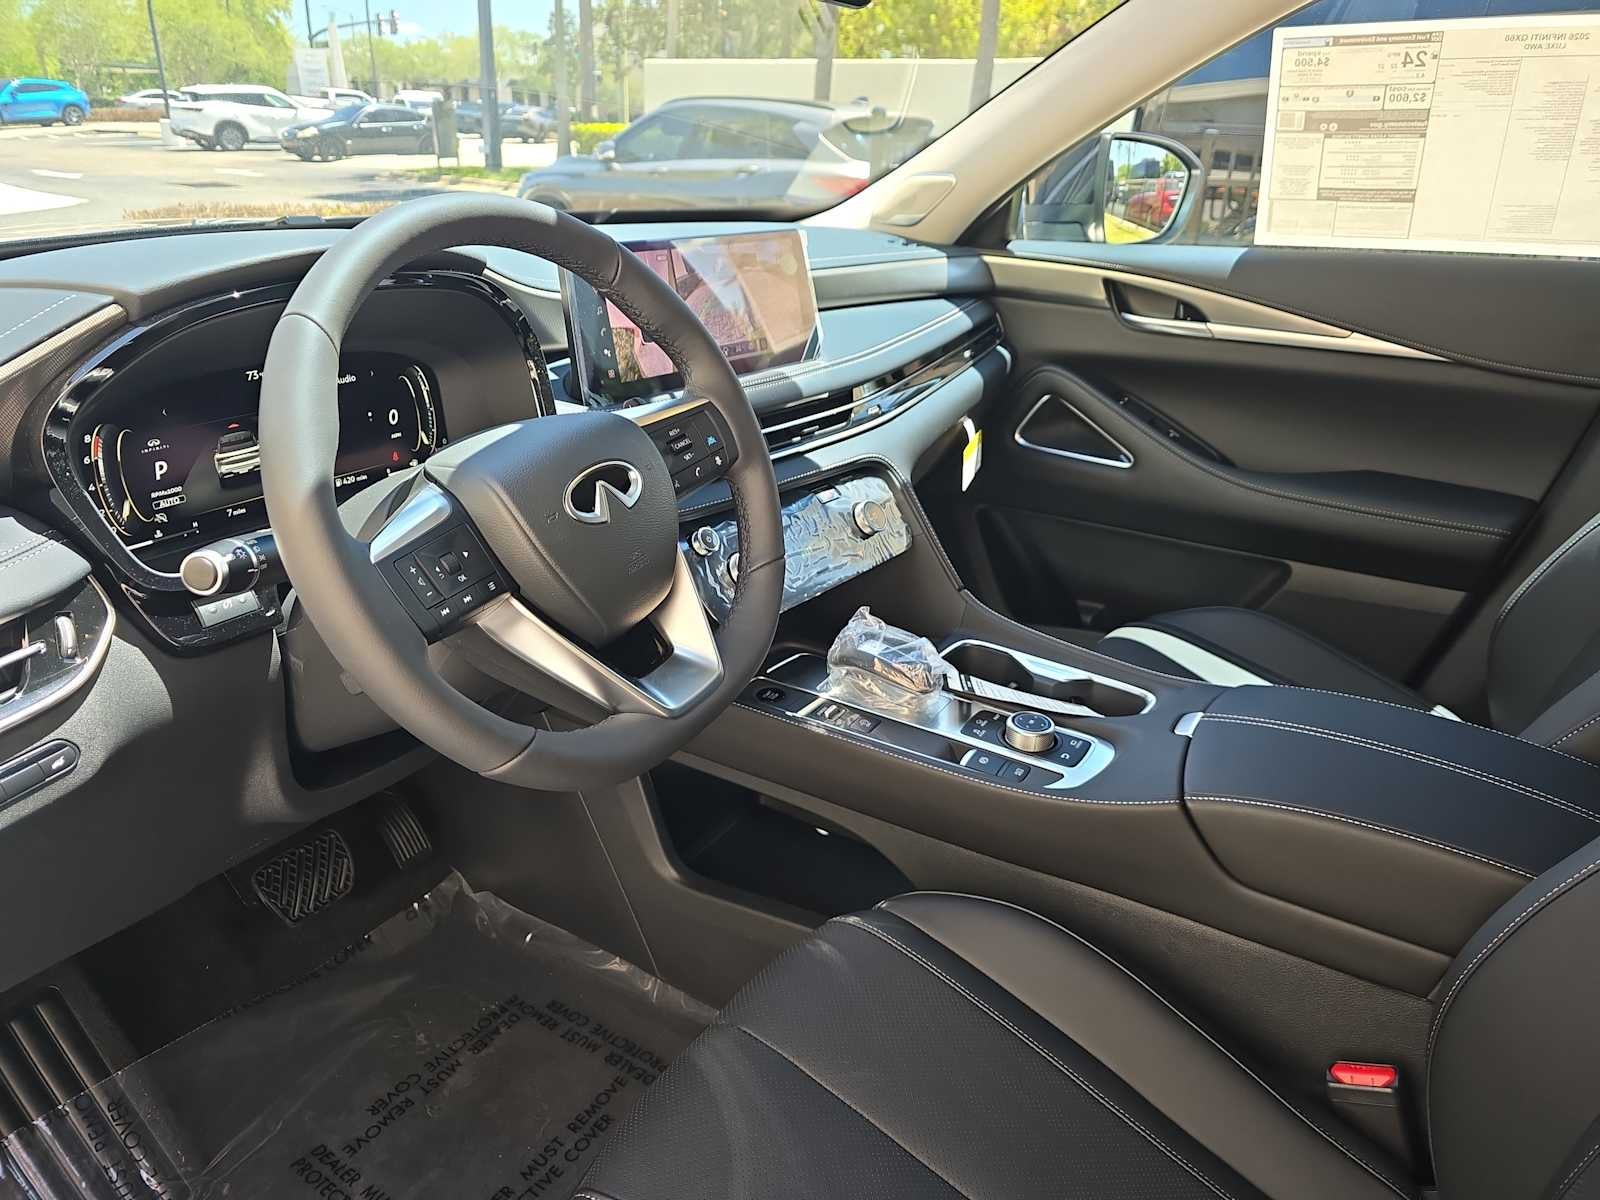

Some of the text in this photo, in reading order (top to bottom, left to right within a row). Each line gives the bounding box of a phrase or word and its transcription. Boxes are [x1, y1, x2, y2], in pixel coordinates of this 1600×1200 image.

[388, 408, 399, 426] 0
[83, 434, 92, 443] 8
[674, 438, 692, 450] CANCEL
[83, 456, 91, 465] 6
[154, 460, 169, 481] P
[342, 474, 356, 485] 420
[88, 483, 96, 492] 4
[159, 497, 181, 508] AUTO
[226, 508, 232, 518] 7
[559, 1028, 602, 1054] MUST
[419, 1058, 463, 1097] MUST
[365, 1072, 422, 1117] COVER
[341, 1097, 416, 1156] REMOVE
[520, 1074, 628, 1182] MUST REMOVE
[563, 1112, 616, 1164] COVER
[310, 1143, 391, 1200] DEALER MU
